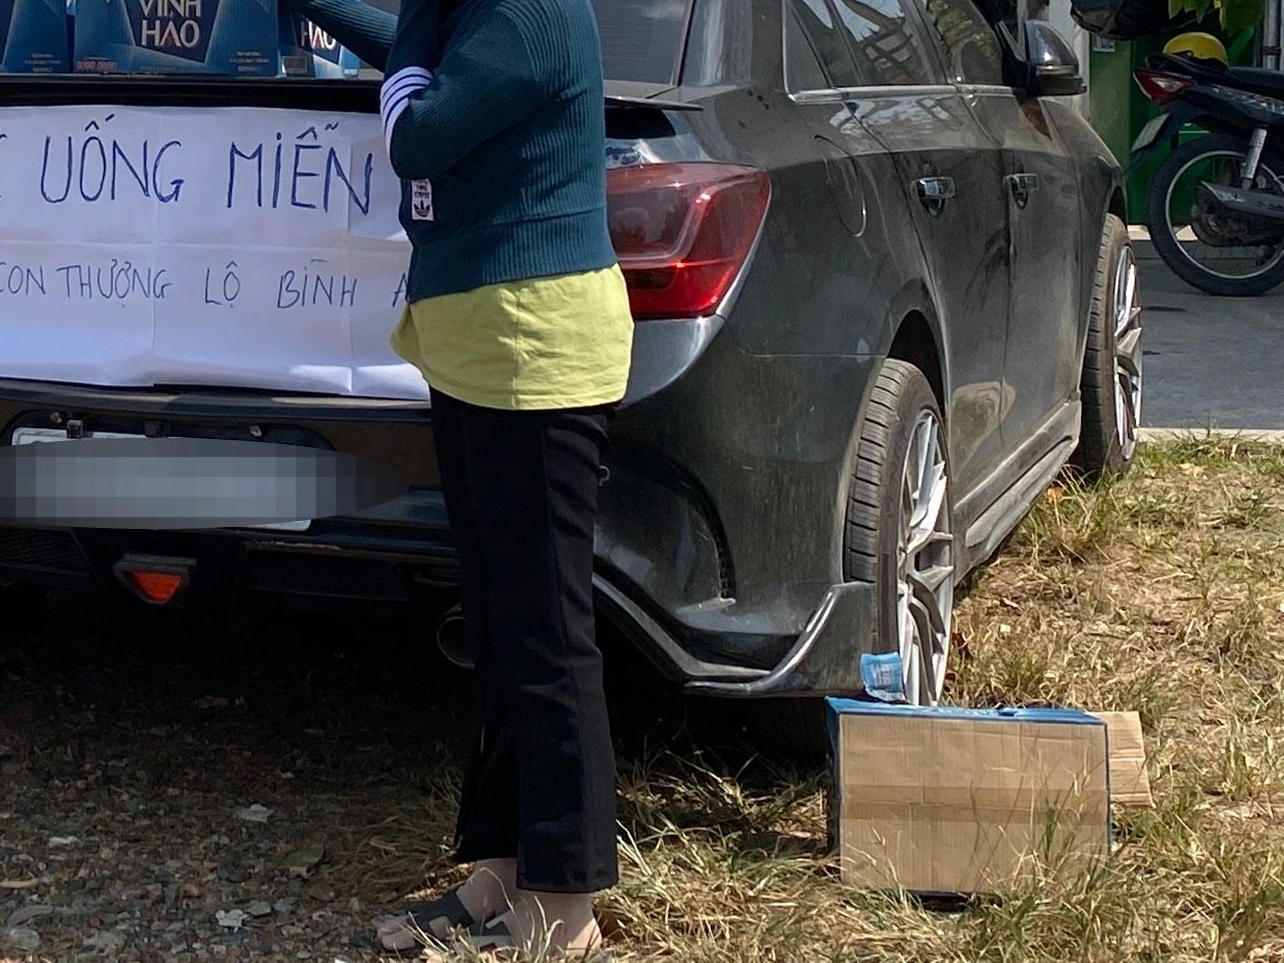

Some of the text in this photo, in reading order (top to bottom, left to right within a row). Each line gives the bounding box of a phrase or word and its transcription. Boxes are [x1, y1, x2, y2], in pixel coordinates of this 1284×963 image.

[40, 114, 182, 205] UỐNG
[227, 121, 373, 214] MIỄN
[57, 256, 173, 310] THƯỢNG
[205, 263, 242, 310] LỘ
